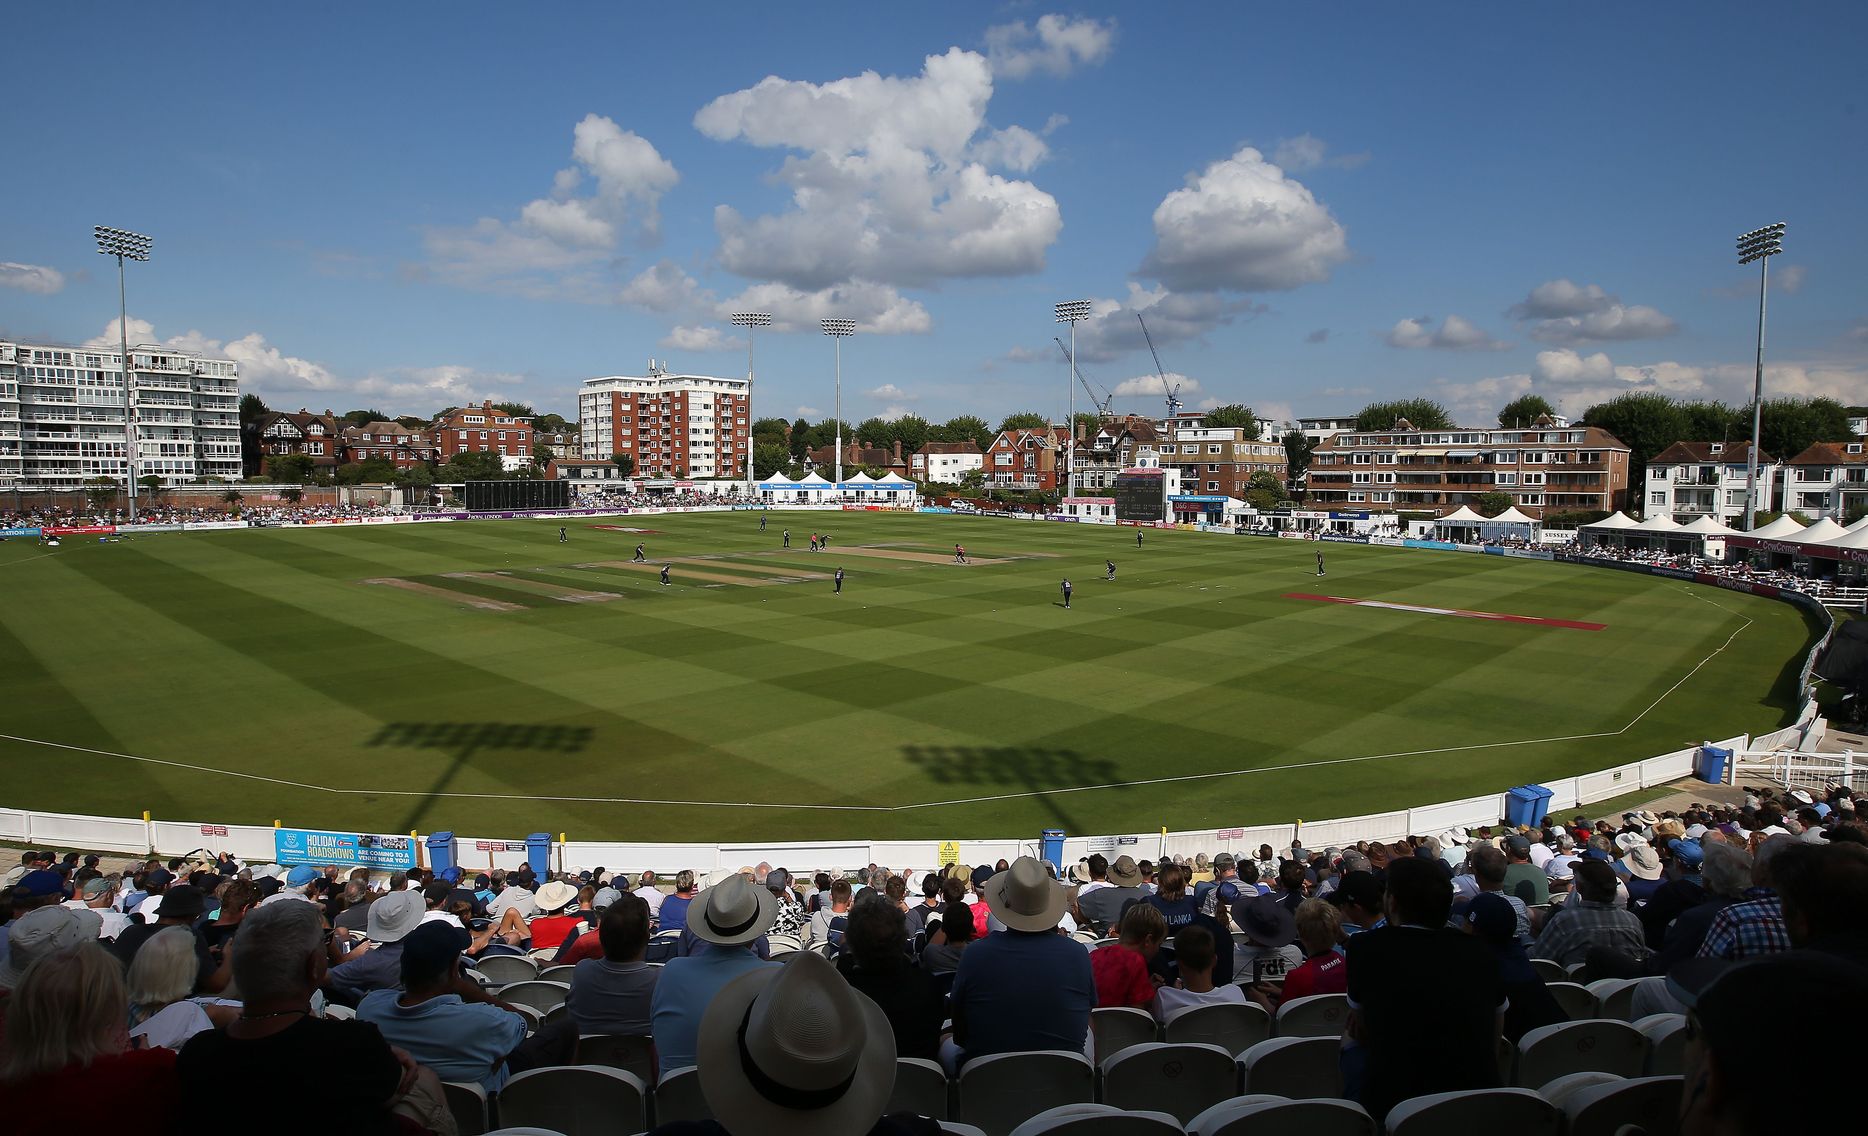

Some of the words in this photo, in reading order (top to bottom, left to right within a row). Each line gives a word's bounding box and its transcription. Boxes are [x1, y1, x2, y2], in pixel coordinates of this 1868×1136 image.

[306, 834, 336, 848] HOLIDAY
[308, 846, 354, 860] ROADSHOWS
[1168, 914, 1192, 924] LANKA
